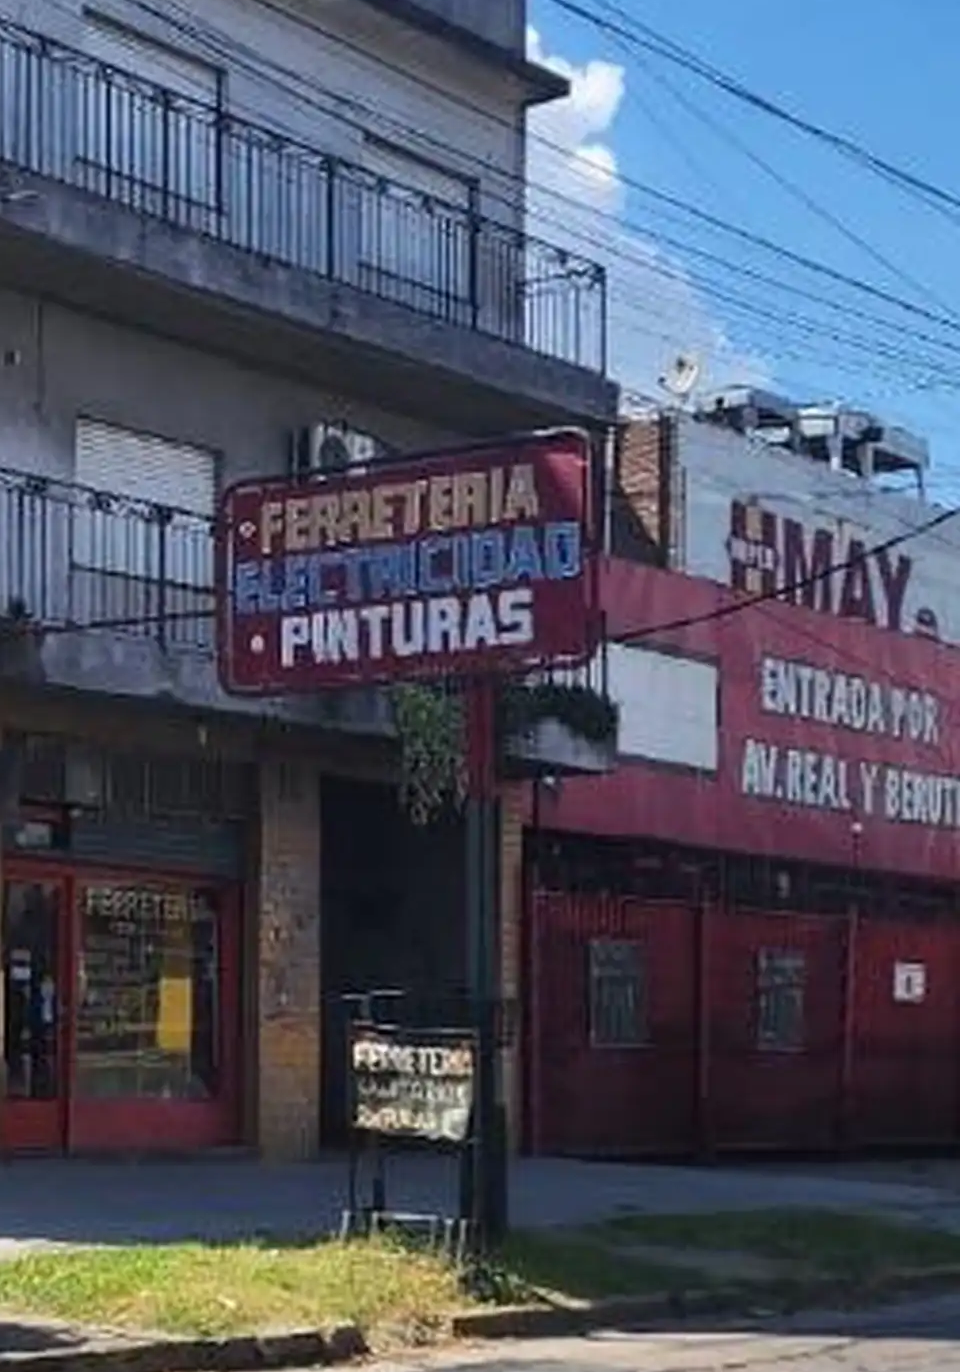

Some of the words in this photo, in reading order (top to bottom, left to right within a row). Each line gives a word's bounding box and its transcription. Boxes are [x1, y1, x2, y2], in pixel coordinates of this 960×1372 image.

[260, 463, 539, 555] FERRETERIA
[234, 521, 580, 613] ELECTRICIDAD
[280, 588, 534, 667] PINTURAS
[761, 657, 885, 733] ENTRADA
[890, 687, 939, 744] POR
[859, 760, 878, 814] Y
